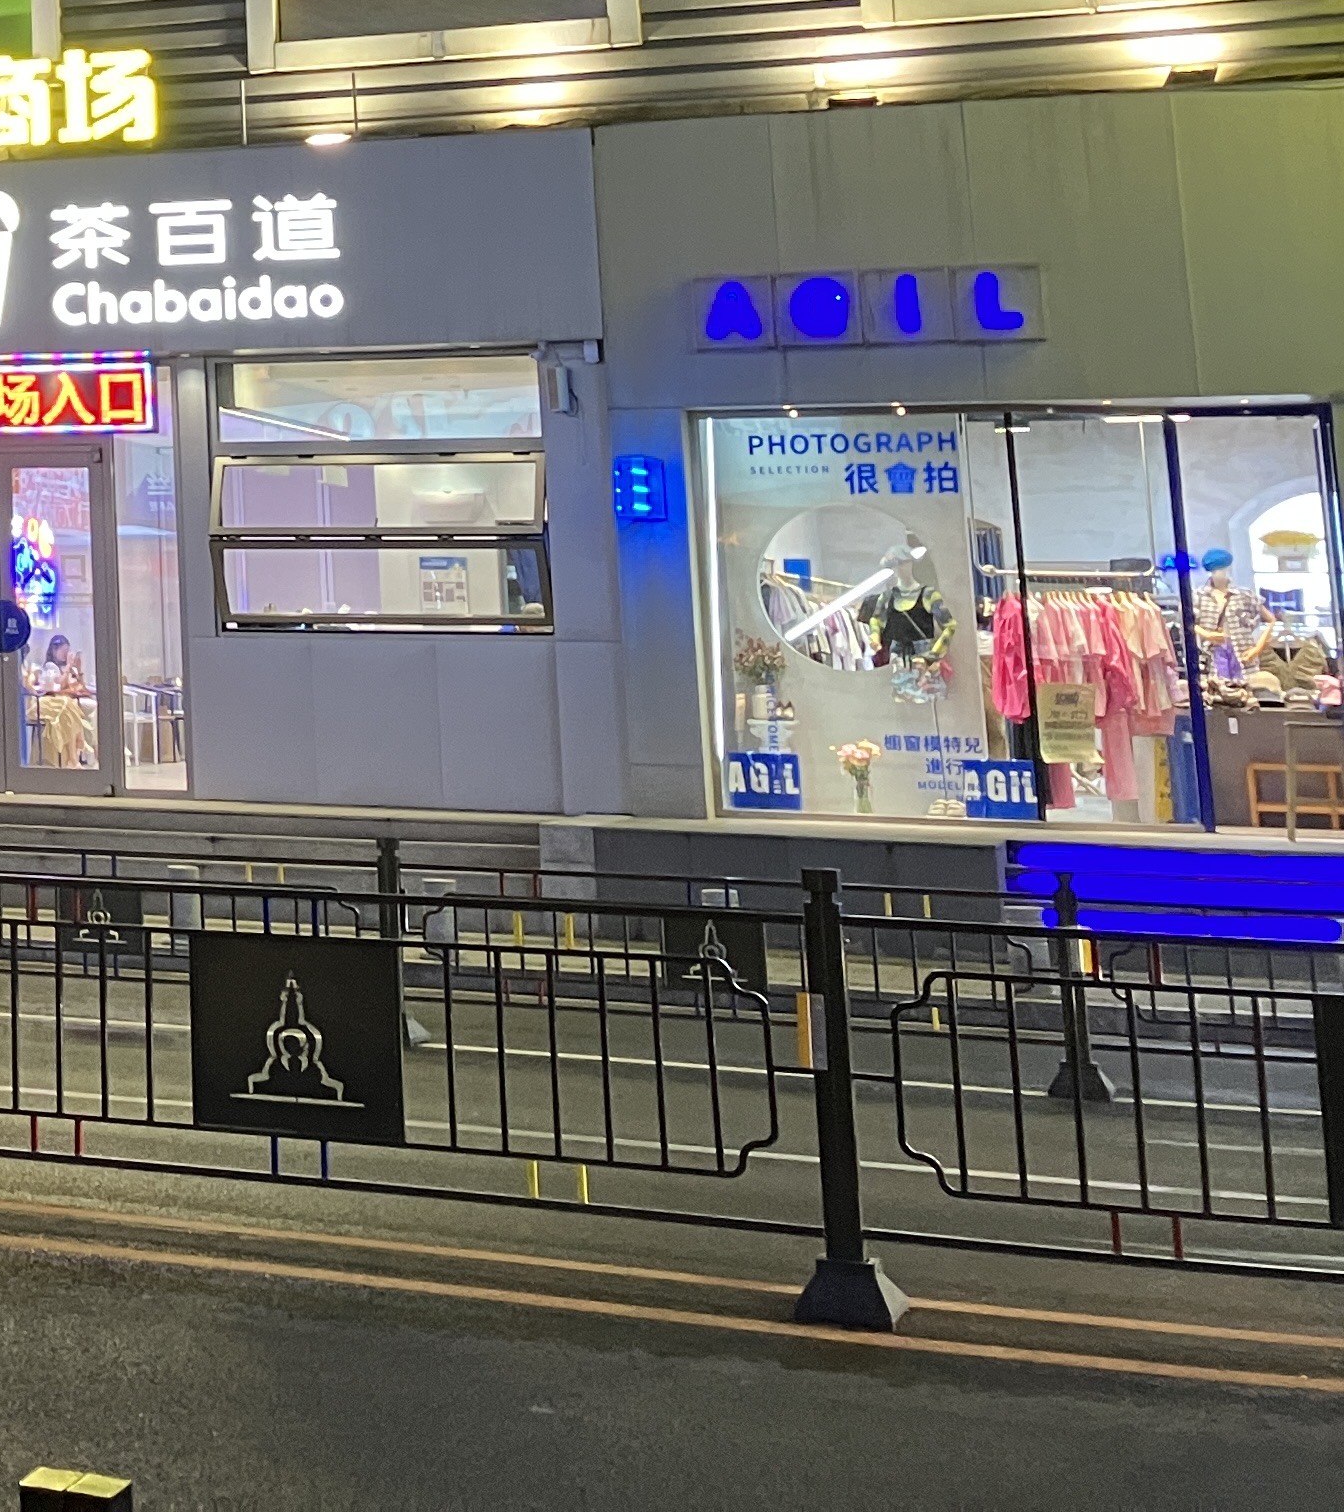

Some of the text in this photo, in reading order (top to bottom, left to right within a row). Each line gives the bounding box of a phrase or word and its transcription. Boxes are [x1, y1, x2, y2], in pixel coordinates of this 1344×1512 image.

[48, 191, 343, 270] 茶百道
[51, 274, 346, 328] Chabaidao
[748, 431, 957, 456] PHOTOGRAPH
[750, 465, 830, 475] SELECTION
[845, 461, 960, 495] 很會拍
